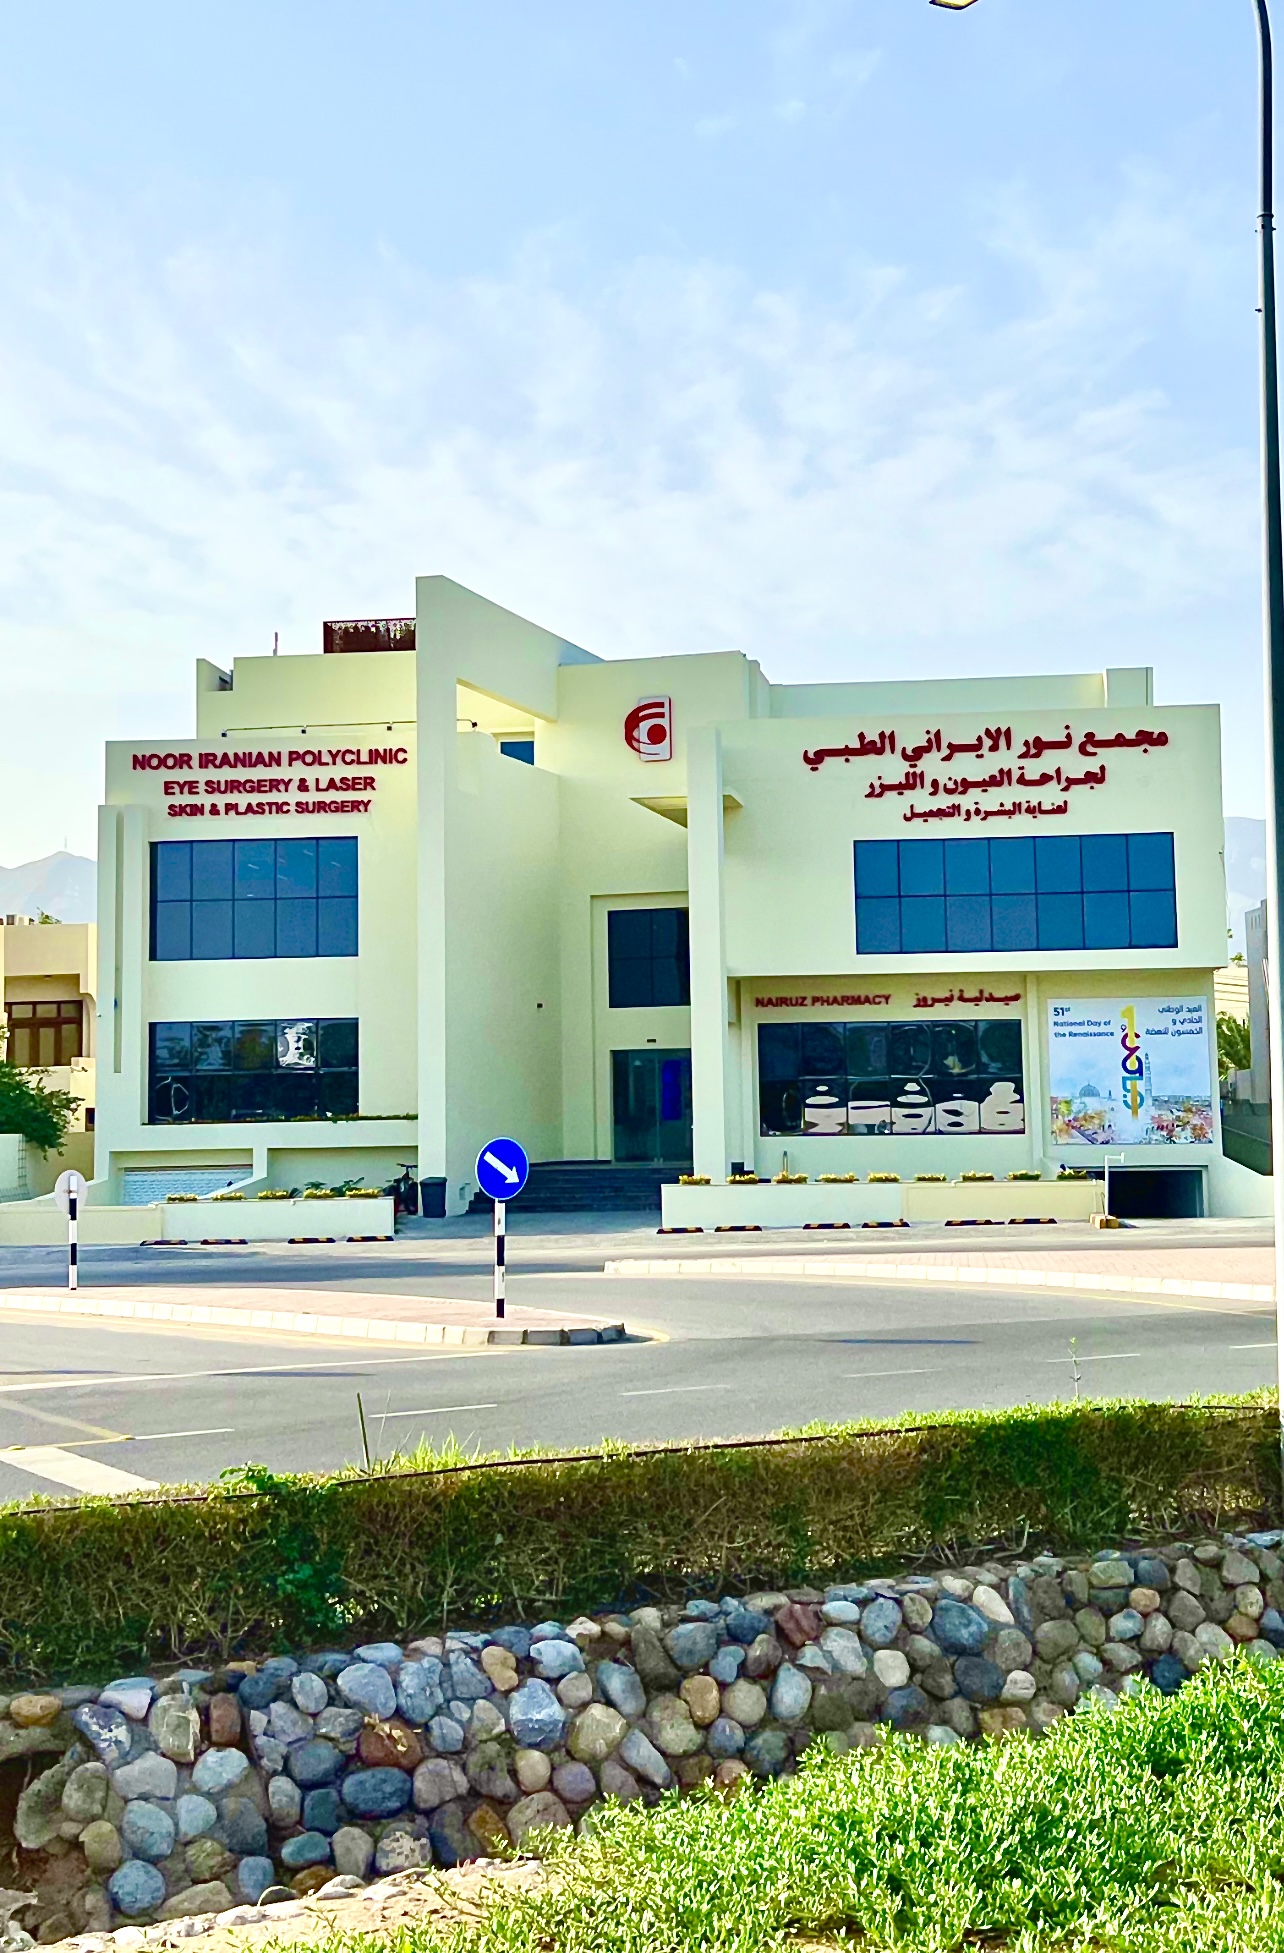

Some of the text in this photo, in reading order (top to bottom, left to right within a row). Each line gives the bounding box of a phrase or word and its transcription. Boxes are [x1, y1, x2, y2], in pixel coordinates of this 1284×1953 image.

[803, 724, 1169, 771] مجمع نور الايراني الطبي
[132, 748, 408, 770] NOOR IRANIAN POLYCLINIC
[164, 776, 376, 796] EYE SURGERY & LASER
[865, 764, 1106, 798] لجراحة العيون و الليزر
[167, 800, 372, 817] SKIN & PLASTIC SURGERY
[903, 800, 1068, 822] لعناية البشرة و التجميل
[755, 994, 891, 1008] NAIRUZ PHARMACY
[913, 988, 1021, 1008] صيدلية نيروز
[1158, 1004, 1203, 1014] العيد الوطني
[1179, 1016, 1203, 1025] الحادي
[1145, 1027, 1203, 1037] الخمسون للنهضة
